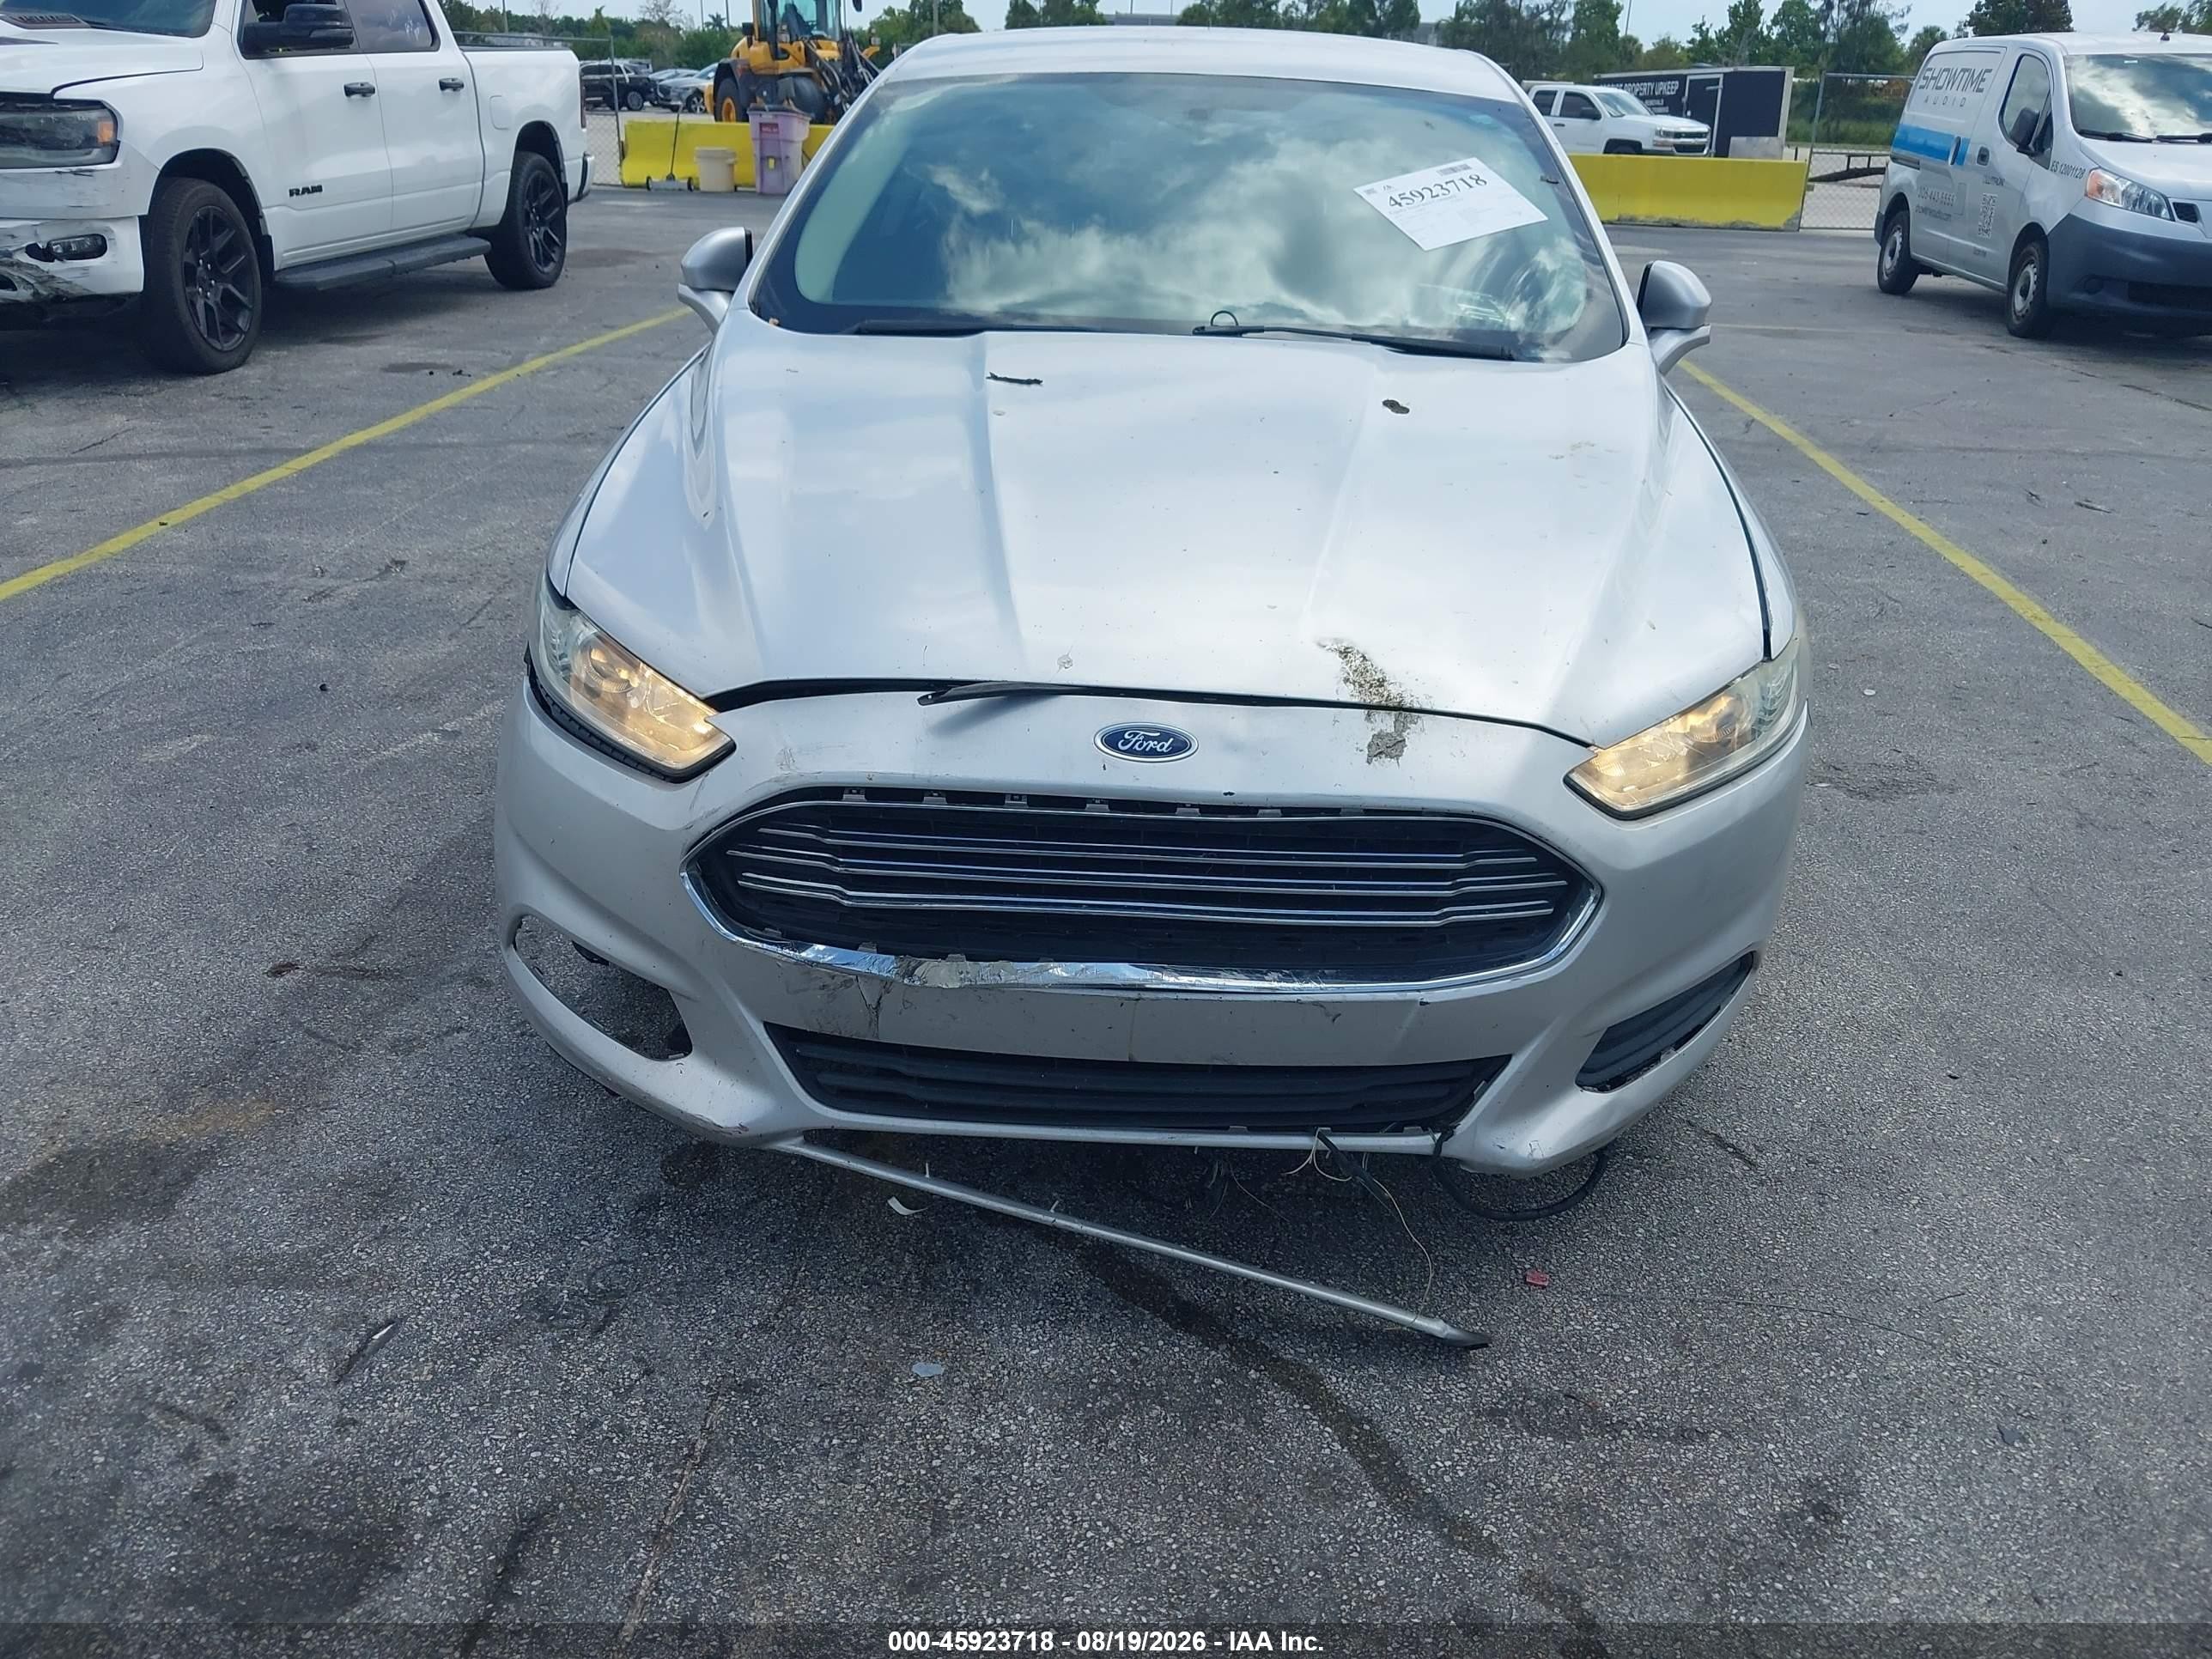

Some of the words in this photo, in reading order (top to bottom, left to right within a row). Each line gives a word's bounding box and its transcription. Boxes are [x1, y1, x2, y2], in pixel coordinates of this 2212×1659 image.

[1624, 82, 1655, 96] PROPERTY
[1655, 81, 1680, 96] UPKEEP
[1918, 67, 1993, 93] SHOWTIME
[1924, 95, 1966, 107] AUDIO
[289, 185, 323, 198] RAM
[1389, 173, 1488, 208] 45923718
[1118, 730, 1175, 753] Ford
